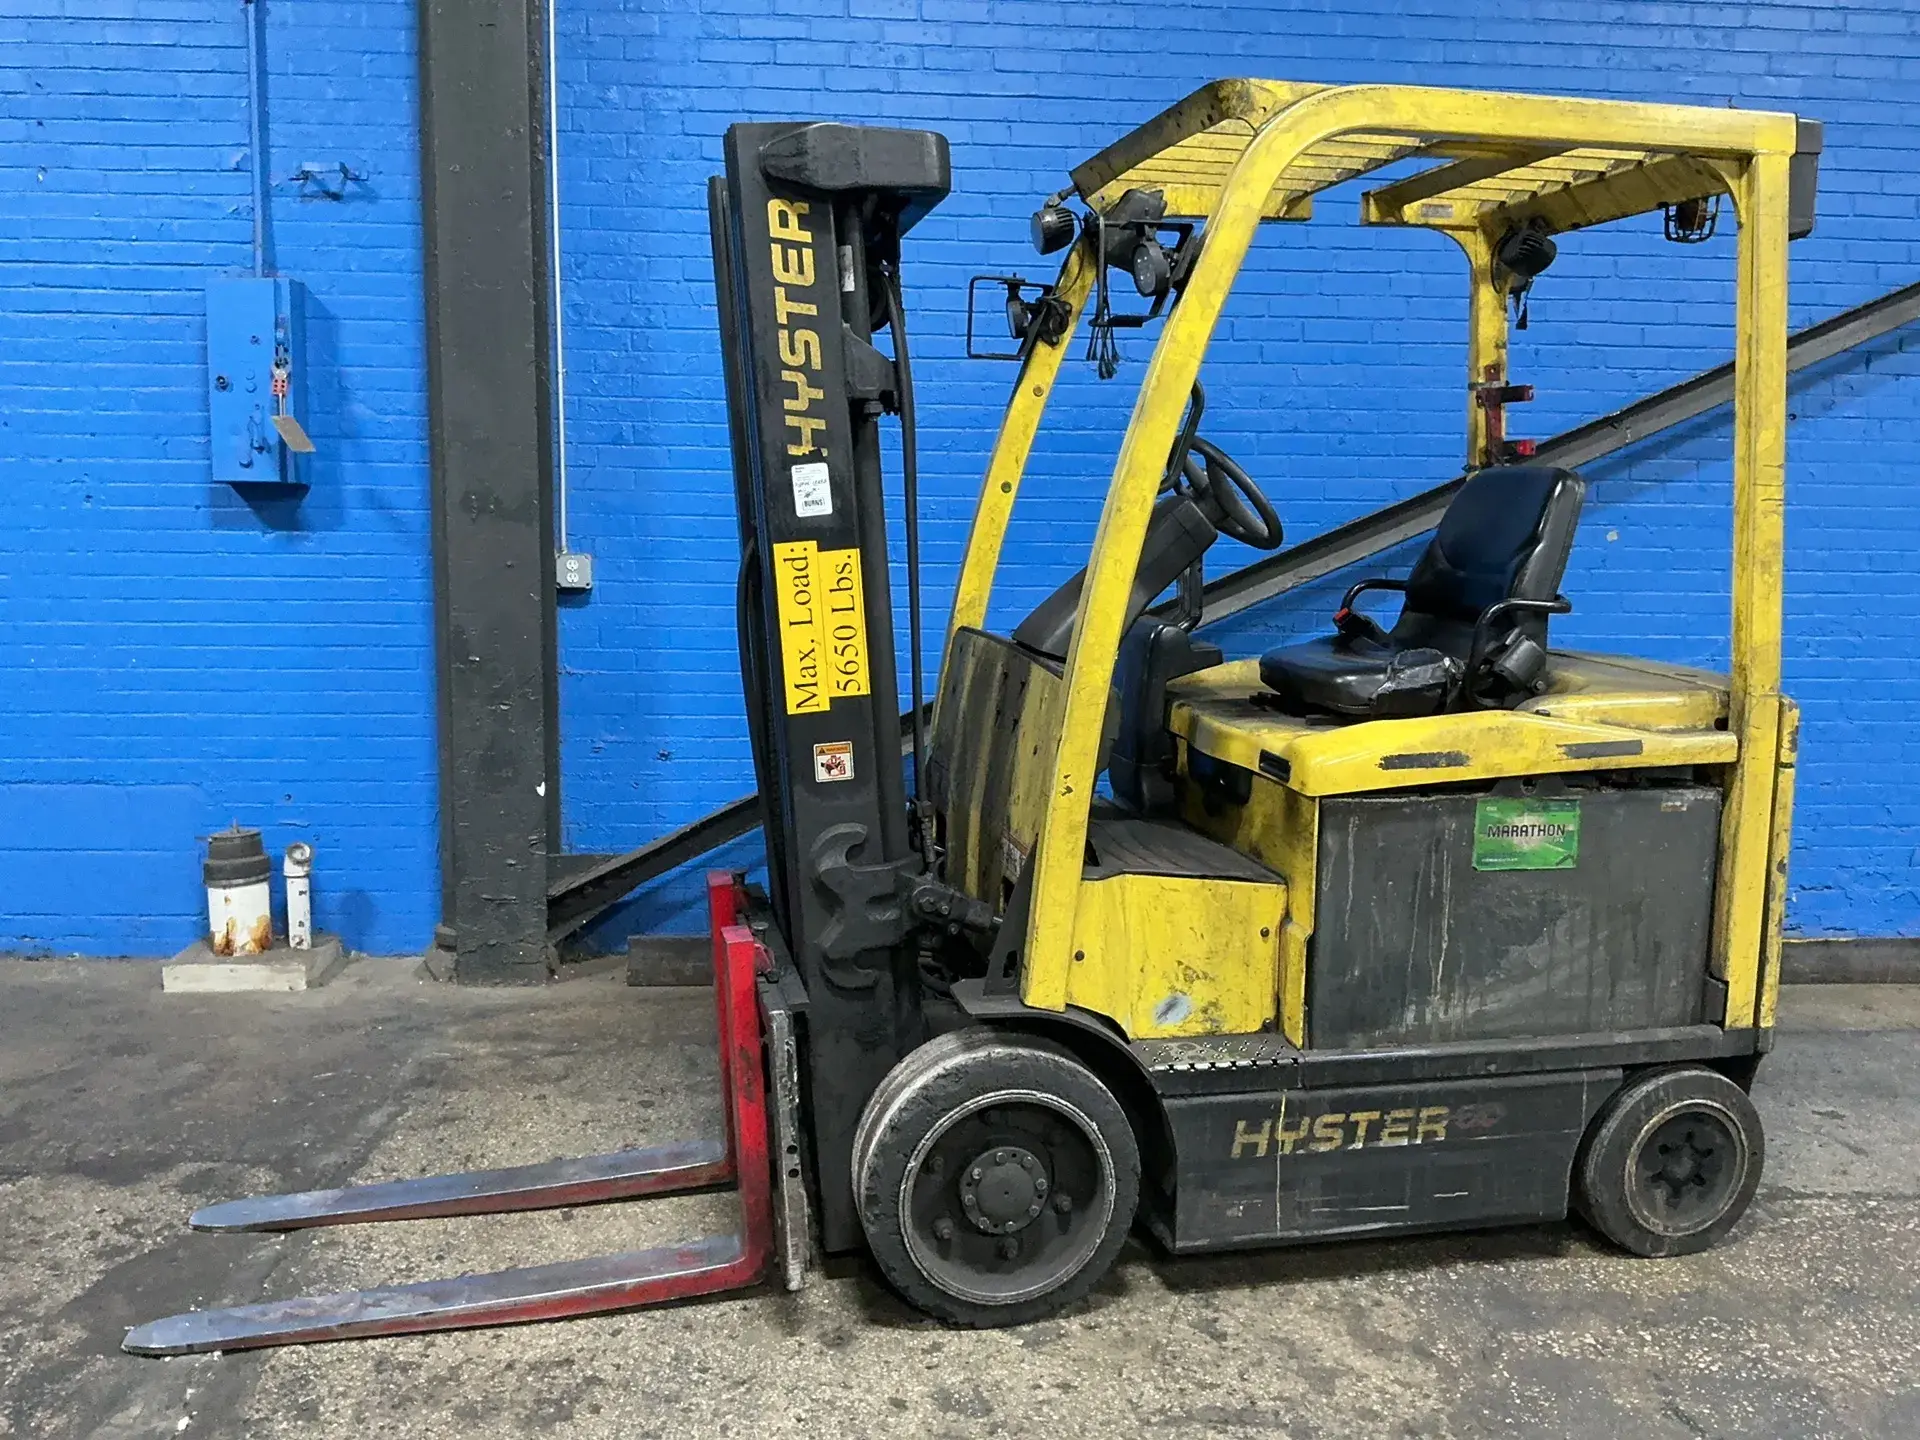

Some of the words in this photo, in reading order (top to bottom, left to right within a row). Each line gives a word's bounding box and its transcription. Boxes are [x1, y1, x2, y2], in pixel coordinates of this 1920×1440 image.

[767, 198, 828, 457] HYSTER
[783, 547, 813, 627] Load:
[829, 554, 856, 613] Lbs.
[794, 638, 820, 710] Max.
[832, 624, 861, 692] 5650
[1487, 823, 1566, 838] MARATHON
[1230, 1106, 1450, 1158] HYSTER
